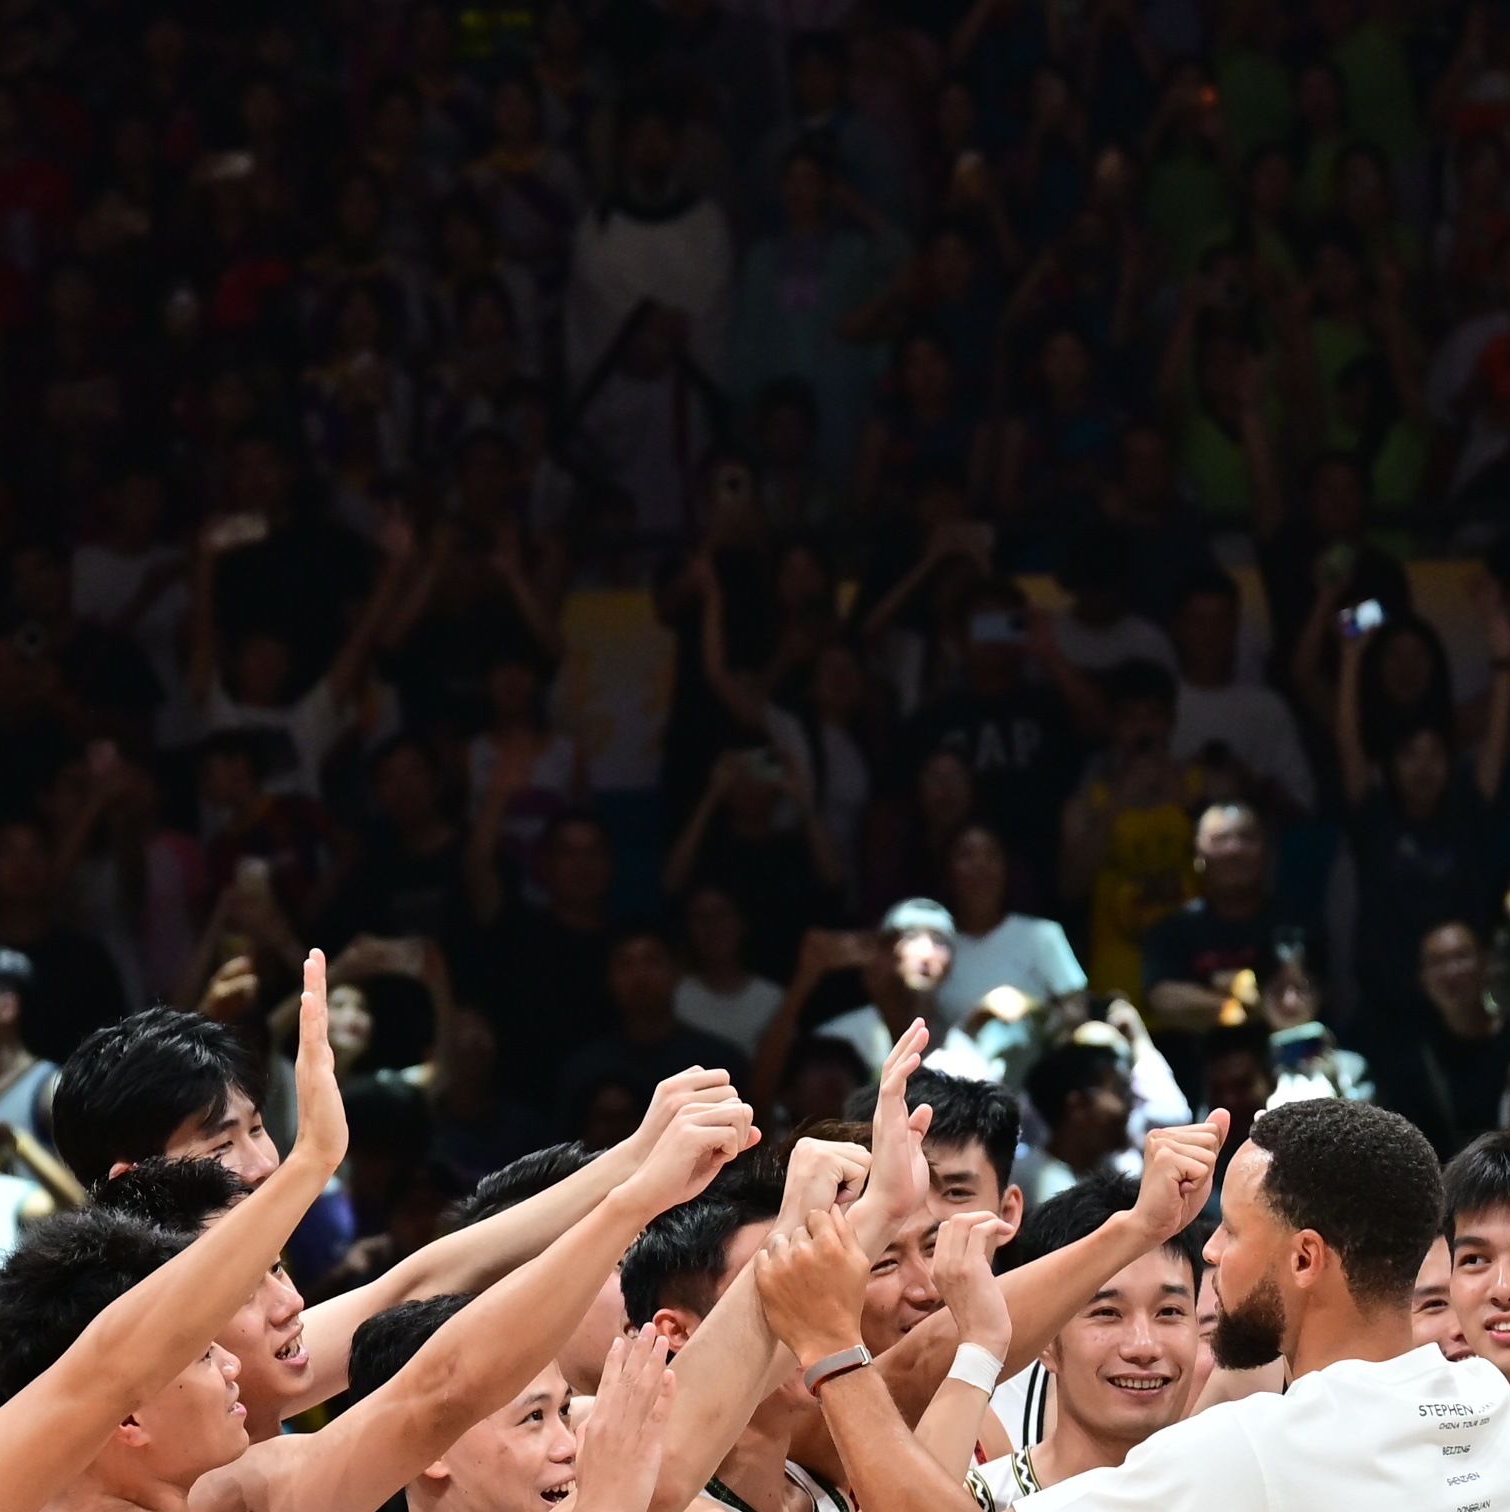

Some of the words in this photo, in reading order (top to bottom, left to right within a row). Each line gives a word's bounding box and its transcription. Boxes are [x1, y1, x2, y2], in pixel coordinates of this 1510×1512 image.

[1418, 1403, 1474, 1417] STEPHEN
[1463, 1420, 1478, 1428] TOUR
[1442, 1444, 1471, 1456] BEIJING
